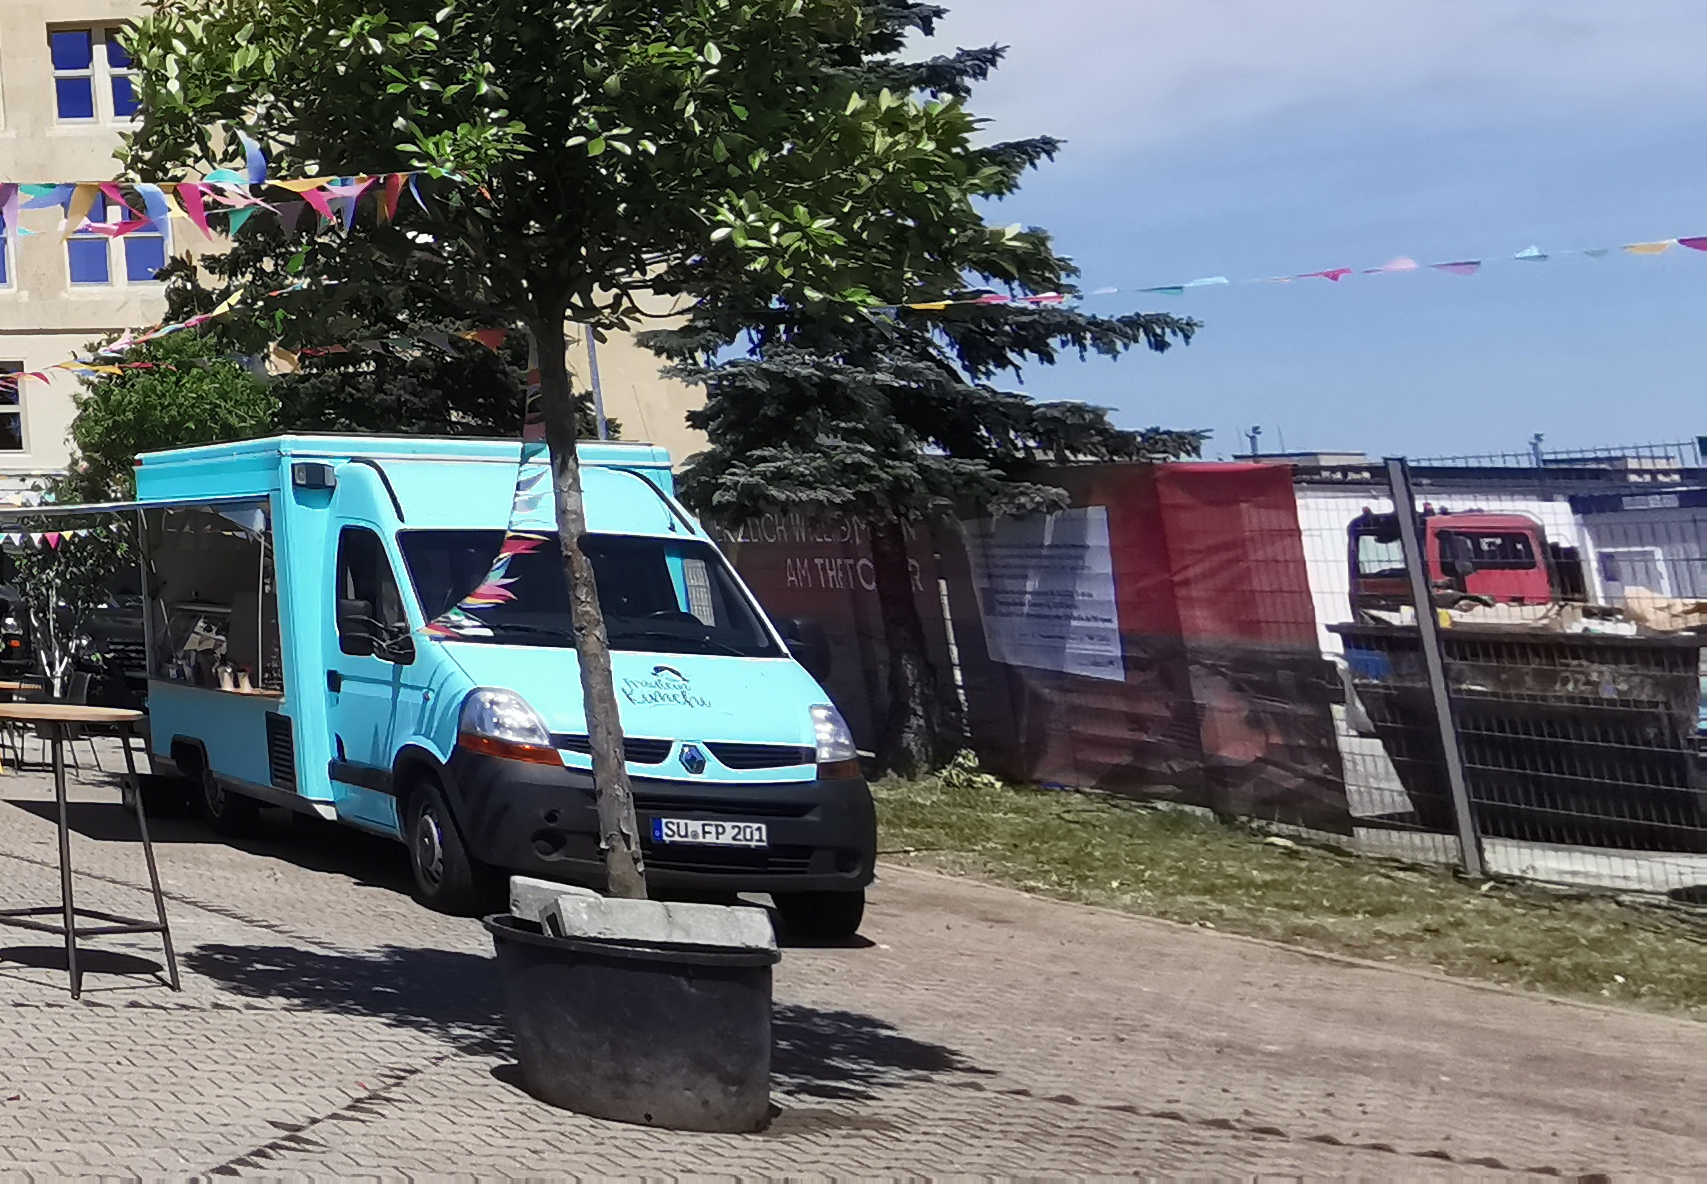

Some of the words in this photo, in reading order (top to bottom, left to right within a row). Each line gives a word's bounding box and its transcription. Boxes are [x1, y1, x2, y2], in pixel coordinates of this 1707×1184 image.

[664, 821, 689, 840] SU
[701, 823, 726, 841] FP
[731, 824, 767, 844] 201
